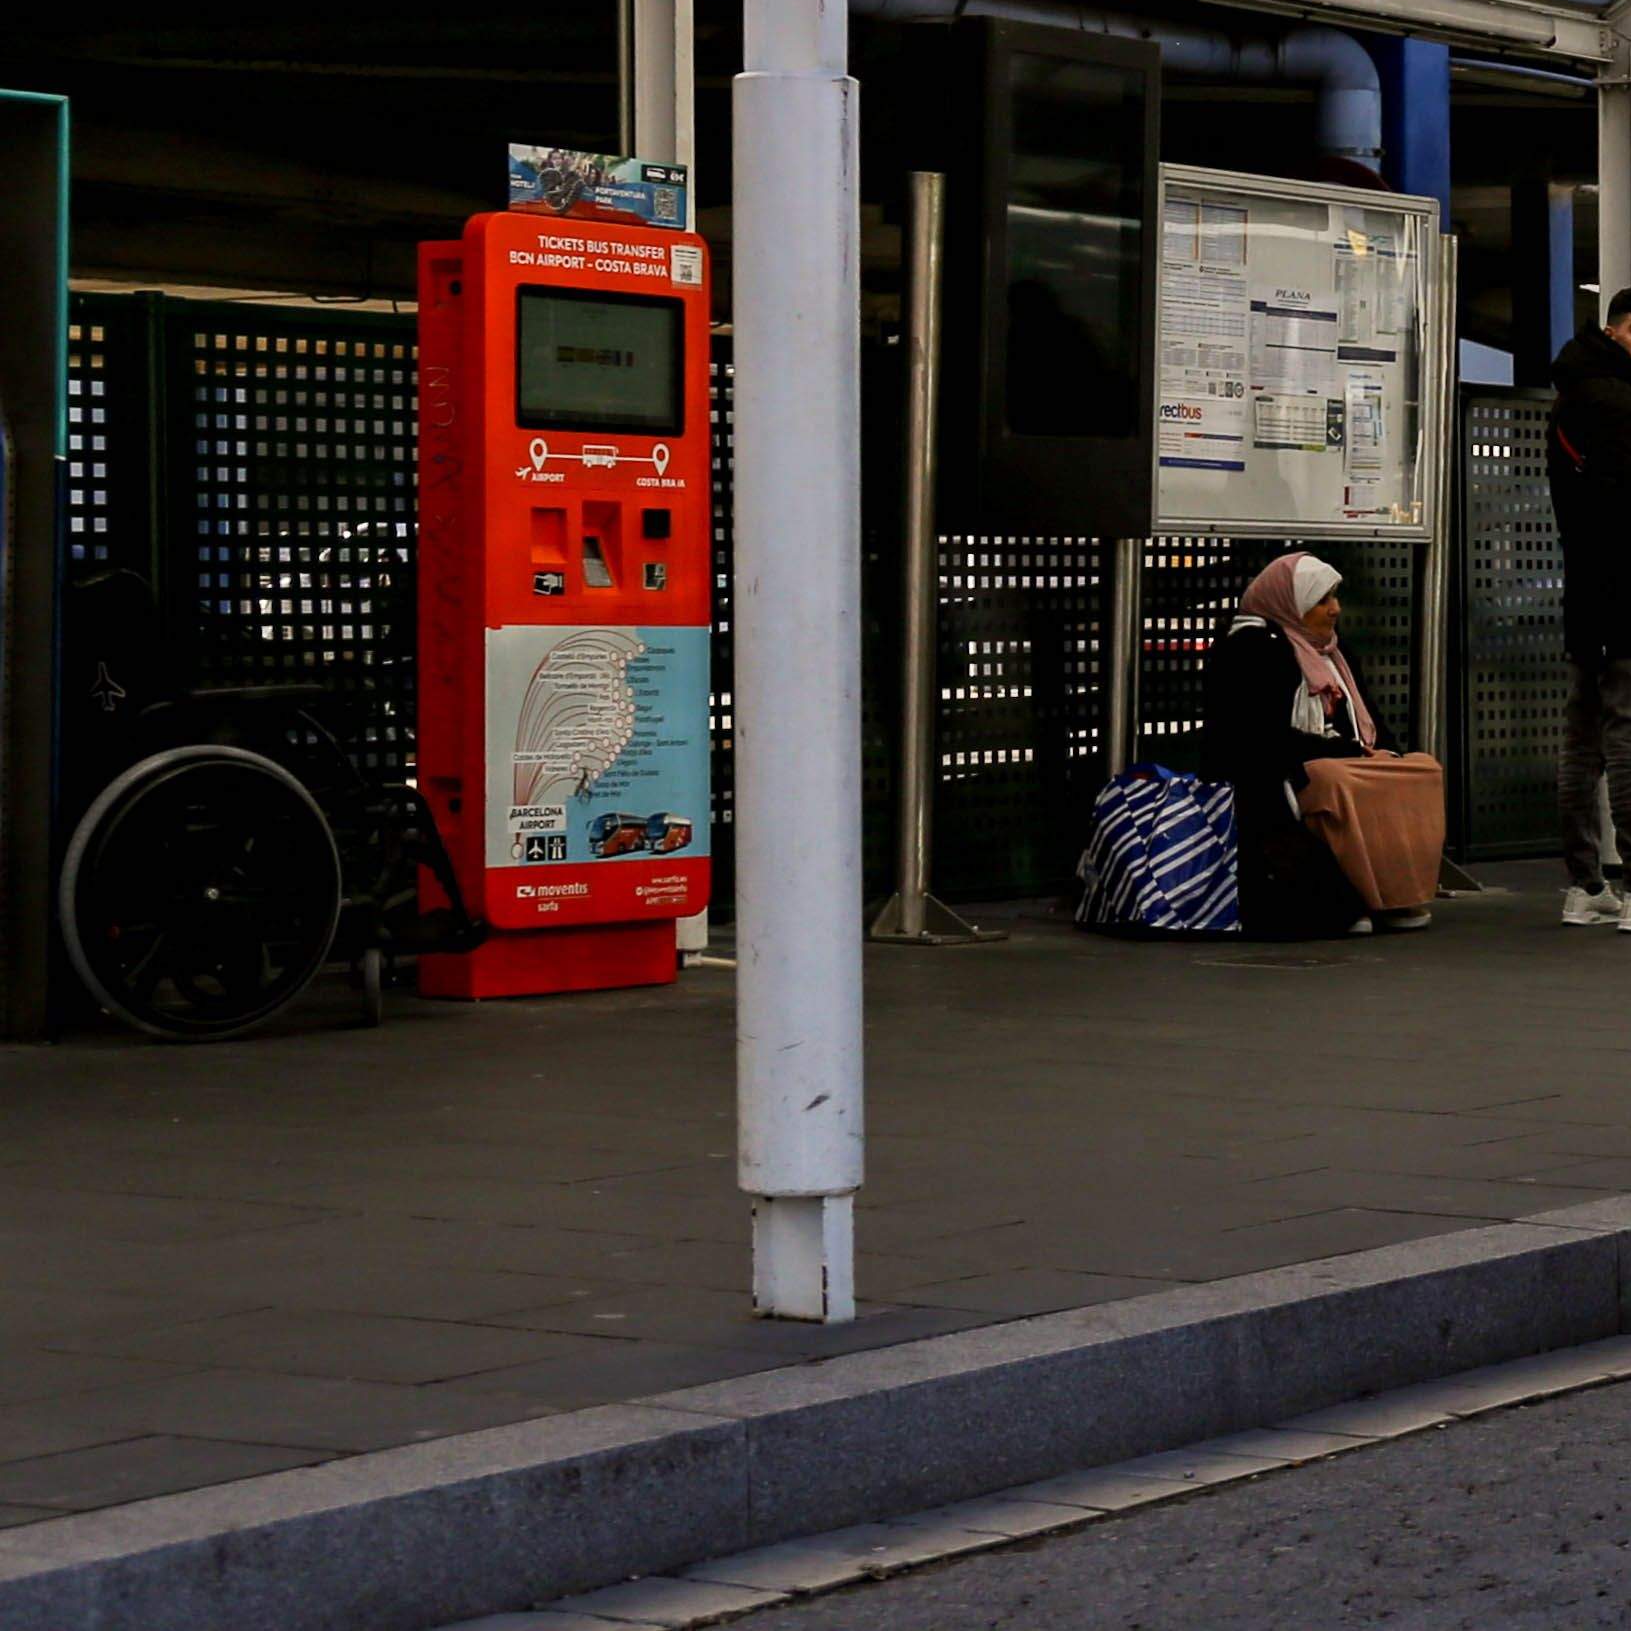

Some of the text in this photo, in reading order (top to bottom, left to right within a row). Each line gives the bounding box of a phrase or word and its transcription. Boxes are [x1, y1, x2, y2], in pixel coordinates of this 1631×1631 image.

[537, 235, 585, 252] TICKETS
[587, 241, 609, 254] BUS
[610, 243, 666, 260] TRANSFER
[509, 251, 535, 265] BCN
[536, 254, 586, 270] AIRPORT
[595, 259, 632, 273] COSTA
[633, 262, 668, 278] BRAVA
[531, 473, 565, 483] AIRPORT
[510, 806, 563, 818] BARCELONA
[519, 819, 556, 830] AIRPORT
[537, 881, 588, 897] moventis
